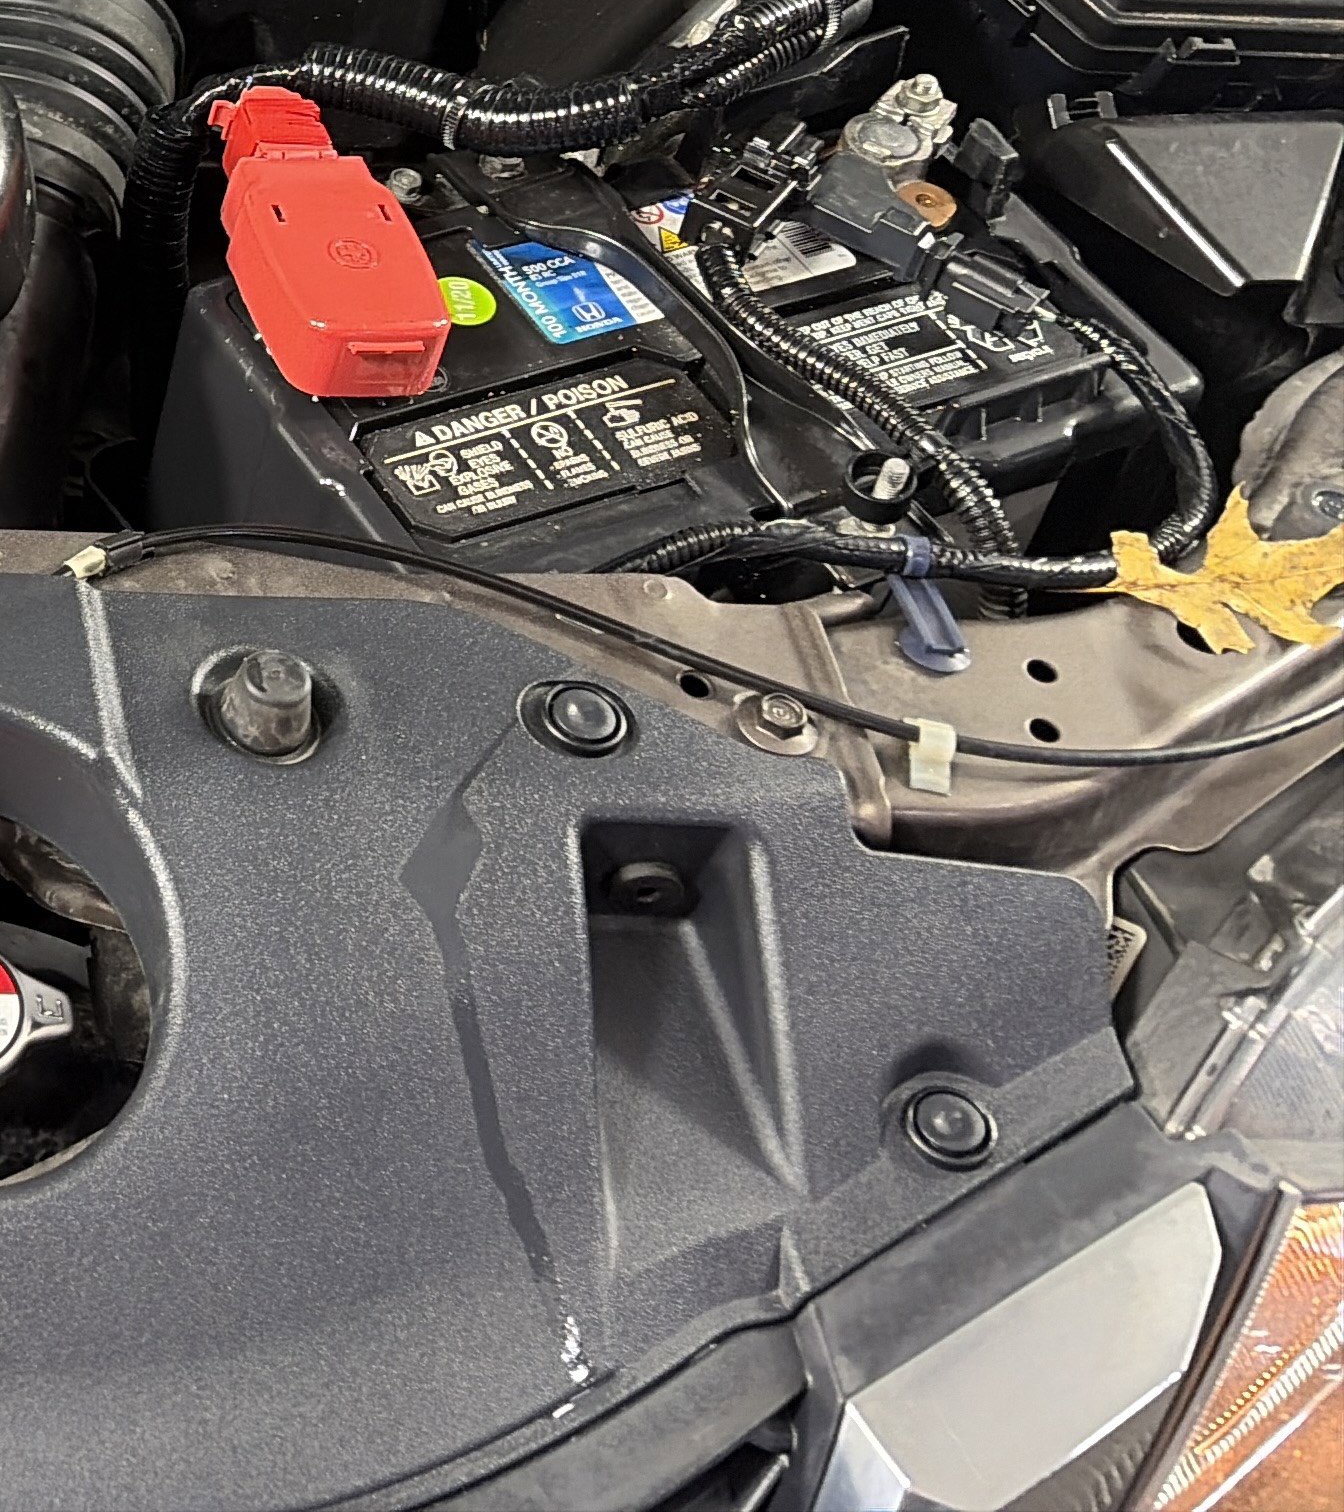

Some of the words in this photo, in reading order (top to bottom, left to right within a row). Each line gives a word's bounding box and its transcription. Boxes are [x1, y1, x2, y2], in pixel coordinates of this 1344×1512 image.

[522, 262, 547, 275] 500
[546, 256, 576, 269] CCA
[498, 266, 549, 315] MONTH
[541, 316, 567, 338] 100
[575, 316, 624, 333] HONDA
[866, 342, 889, 356] GET
[882, 347, 910, 363] FAST
[431, 404, 527, 441] DANGER
[530, 398, 538, 416] /
[541, 375, 629, 410] POISON
[615, 419, 671, 441] SULFURIC
[671, 411, 699, 426] ACID
[460, 441, 504, 459] SHIELD
[552, 445, 573, 460] NO
[467, 453, 501, 469] EYES
[448, 460, 514, 486] EXPLOSIVE
[457, 477, 500, 496] GASES
